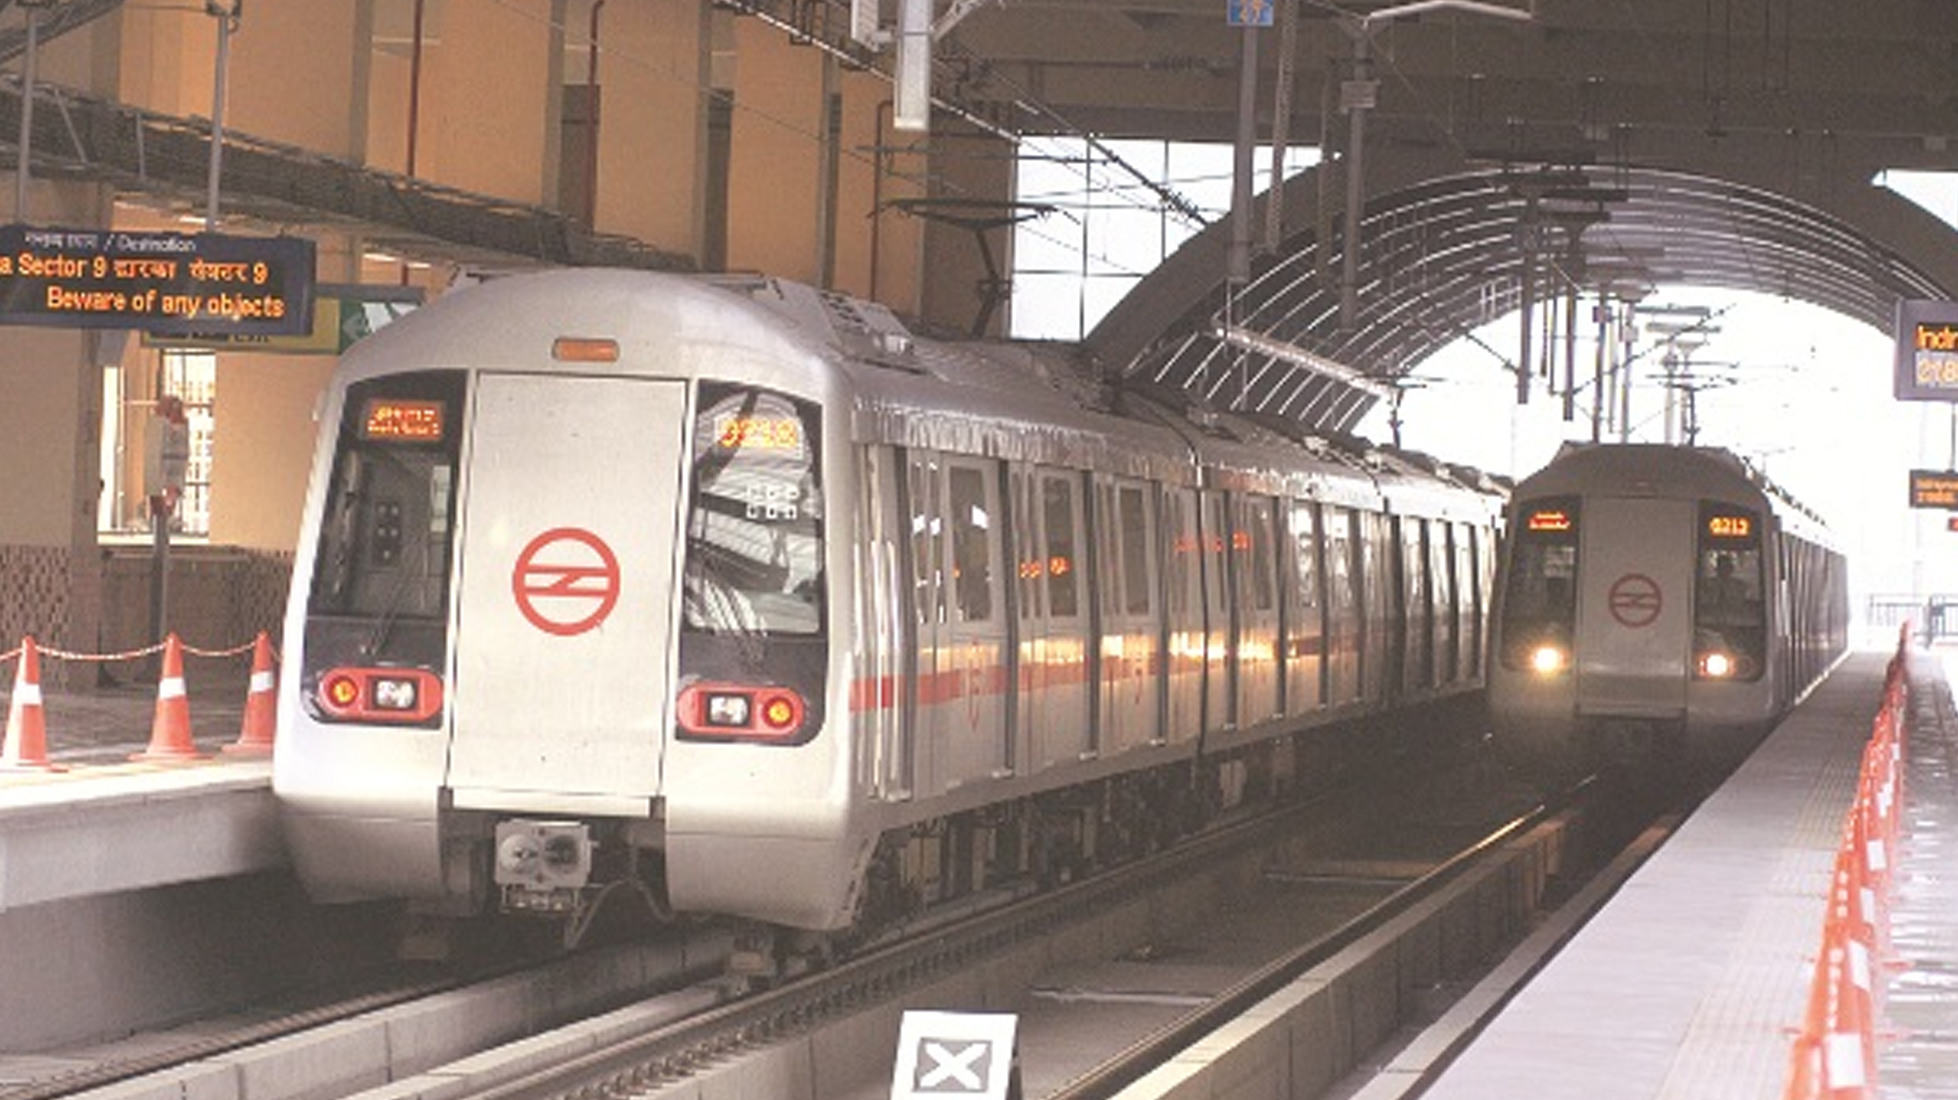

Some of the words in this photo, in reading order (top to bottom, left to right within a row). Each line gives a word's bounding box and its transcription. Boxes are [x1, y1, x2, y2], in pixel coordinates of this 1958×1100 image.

[18, 253, 87, 278] Sector
[93, 255, 107, 278] 9
[253, 261, 268, 285] 9
[47, 285, 126, 311] Beware
[132, 288, 157, 312] of
[162, 294, 201, 319] any
[207, 293, 285, 321] objects
